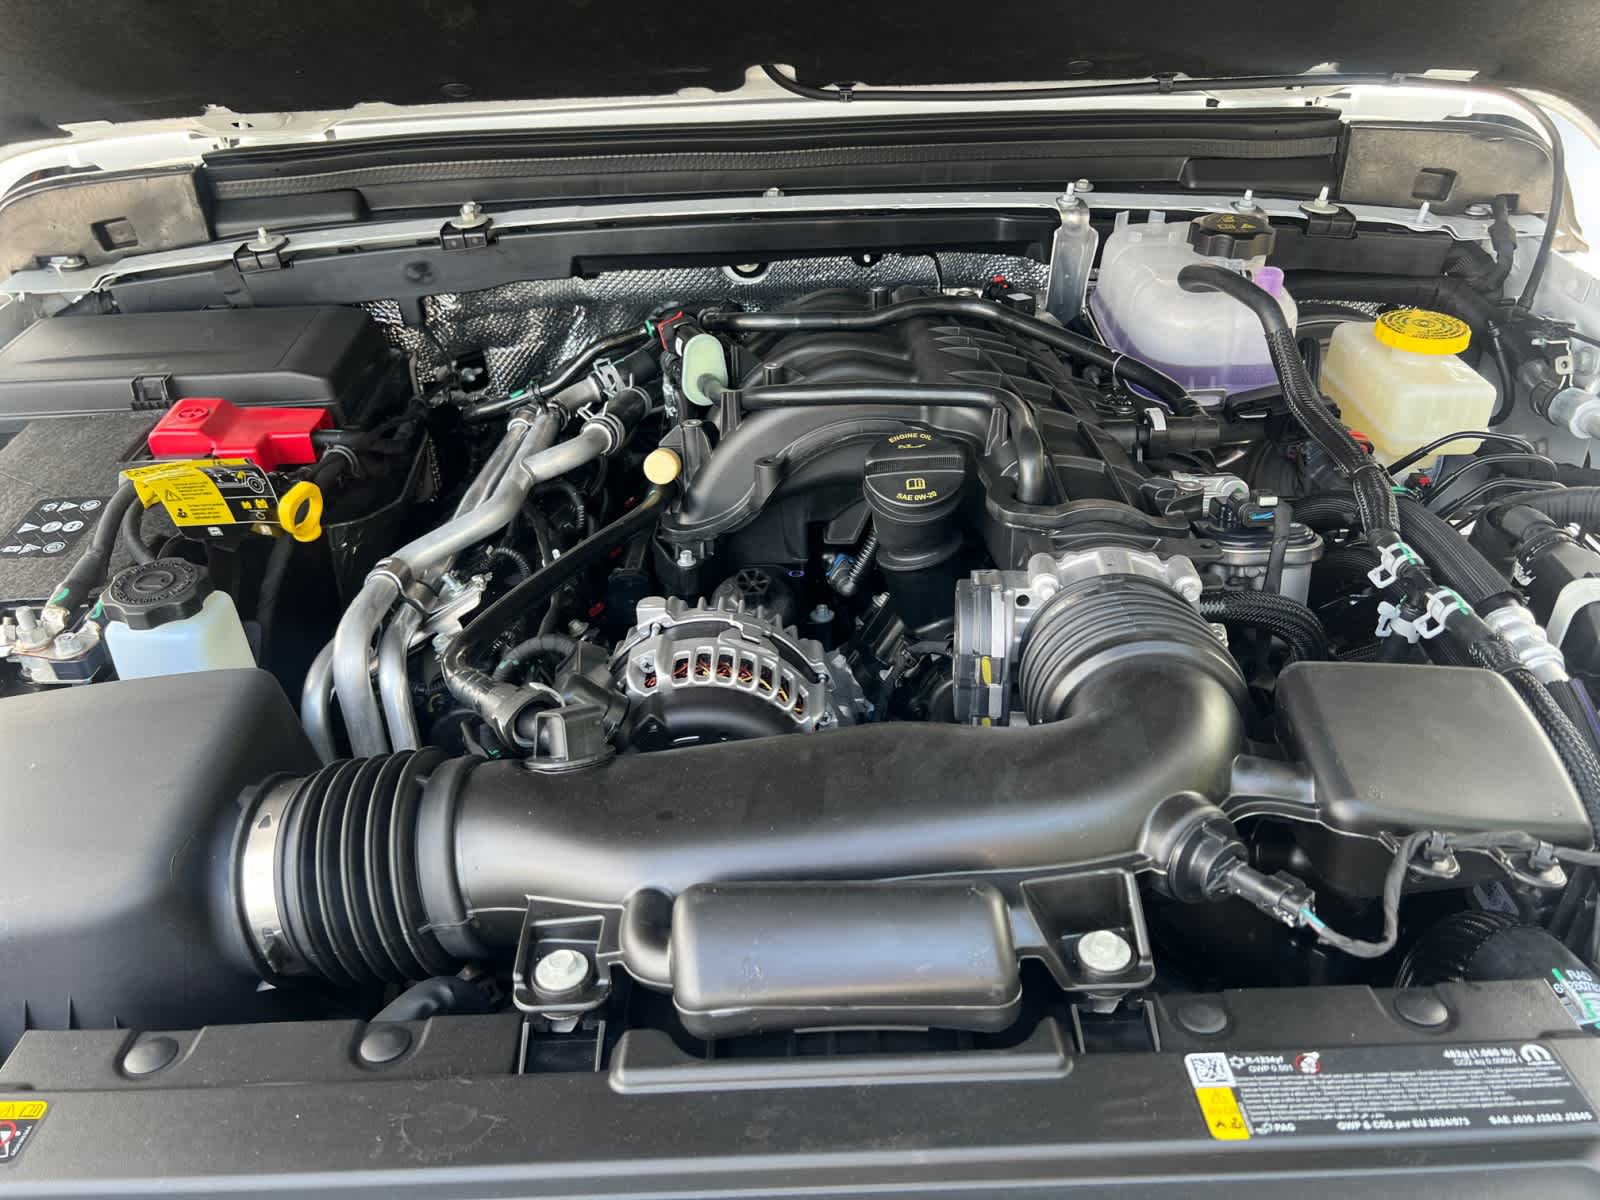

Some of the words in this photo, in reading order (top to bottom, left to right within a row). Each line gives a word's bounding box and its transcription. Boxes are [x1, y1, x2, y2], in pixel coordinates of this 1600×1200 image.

[888, 432, 918, 444] ENGINE
[919, 433, 933, 441] OIL
[896, 492, 913, 501] SAE
[1488, 1114, 1511, 1125] SAE
[1336, 1120, 1361, 1130] GWP
